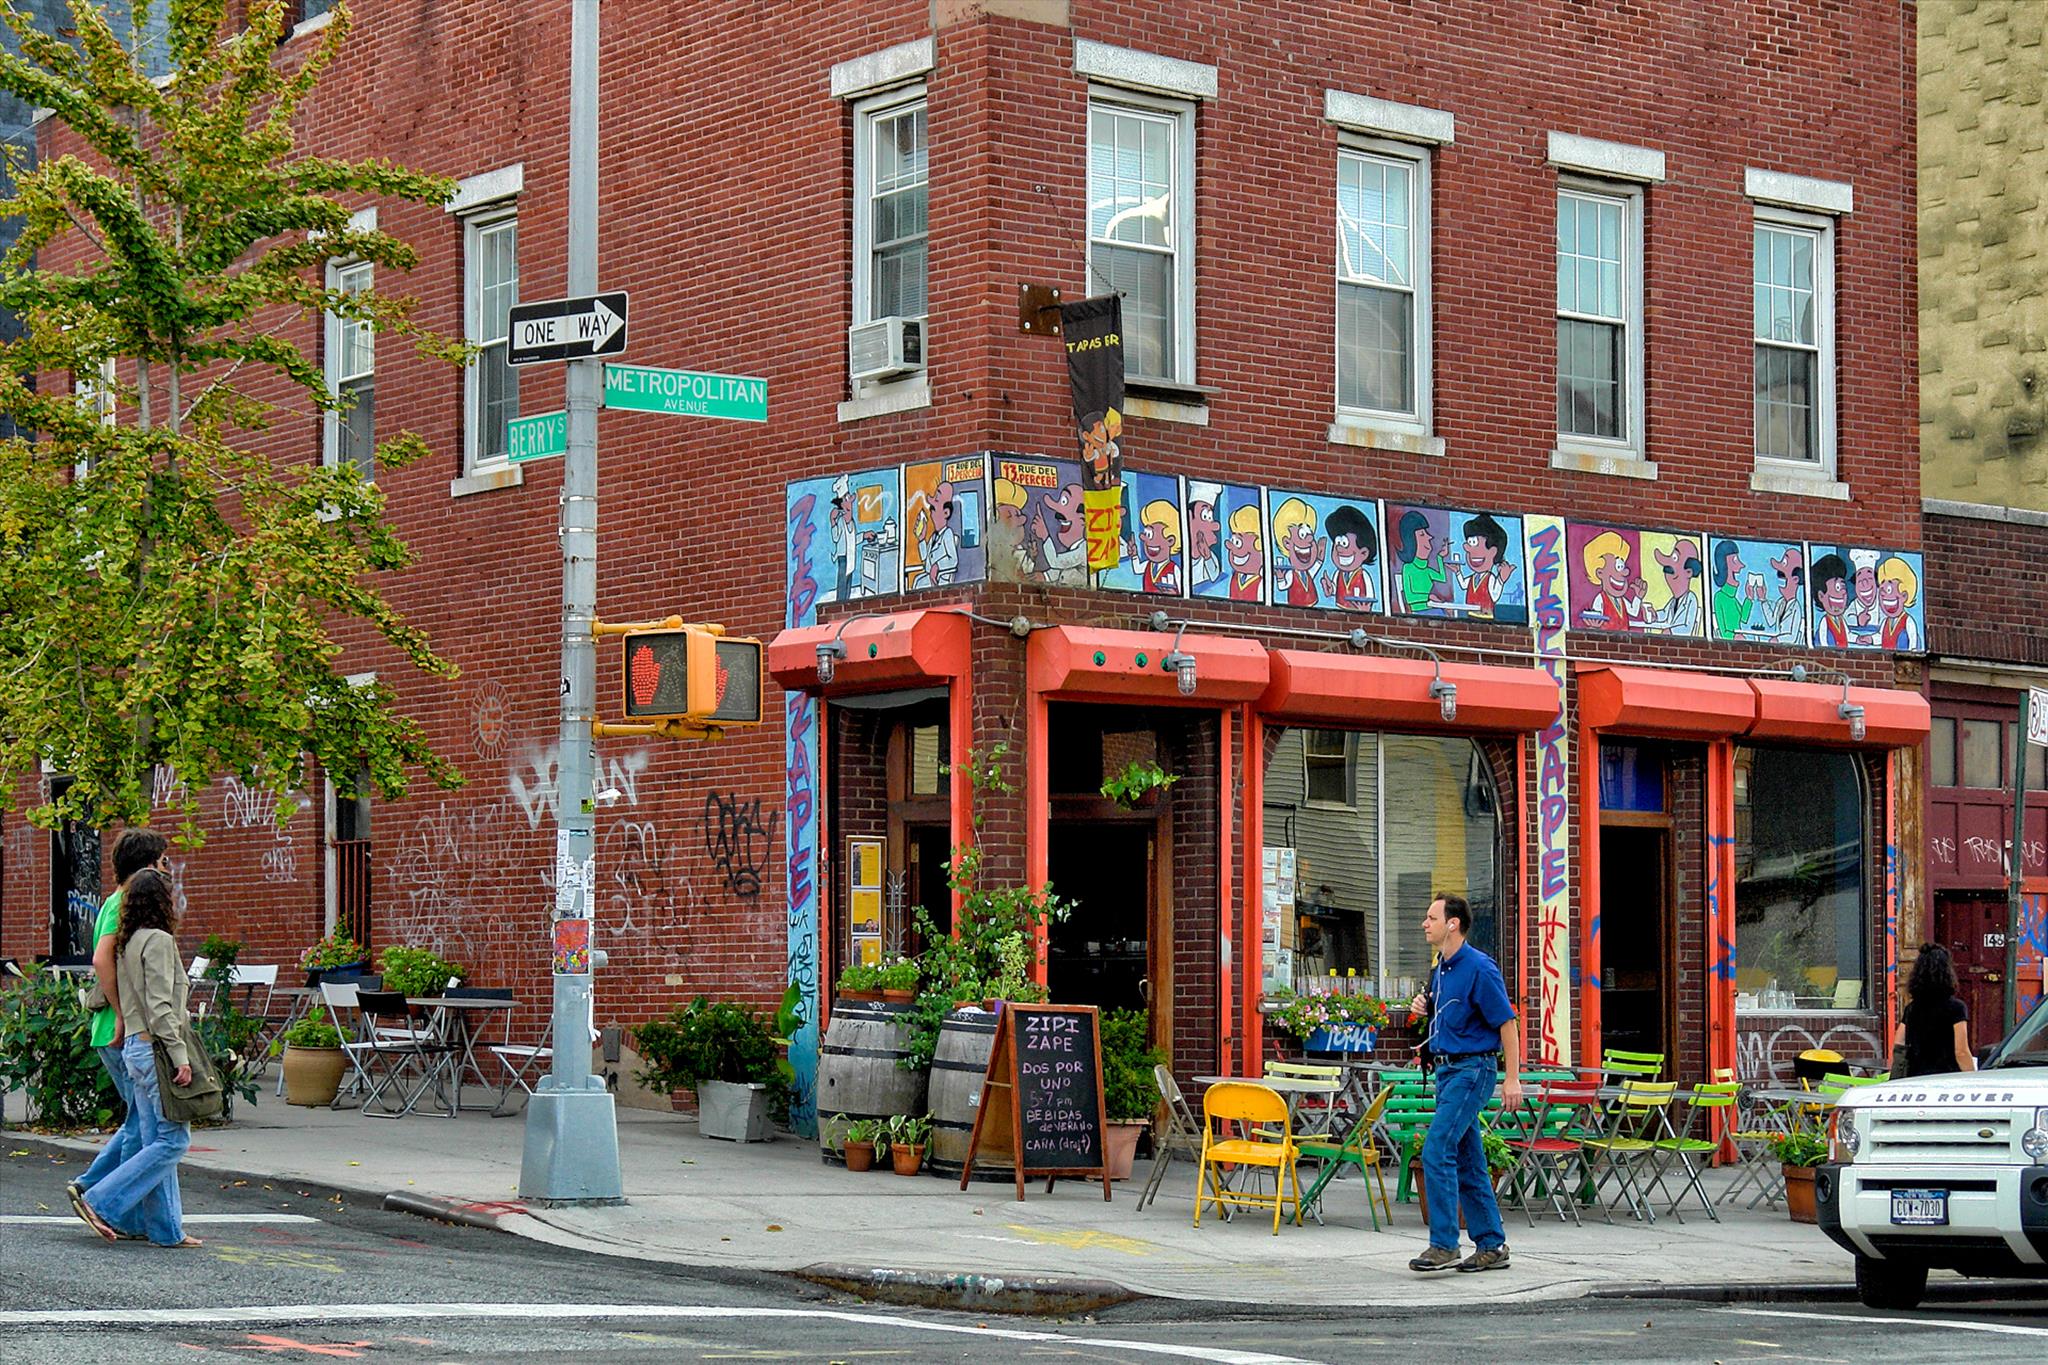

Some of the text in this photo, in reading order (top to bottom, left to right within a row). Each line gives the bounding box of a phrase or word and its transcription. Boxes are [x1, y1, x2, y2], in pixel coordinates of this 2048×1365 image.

[524, 313, 612, 345] ONE WAY
[1066, 337, 1102, 353] TAPAS
[606, 368, 765, 404] METROPOLITAN
[664, 399, 709, 414] AVENUE
[511, 416, 567, 458] BERRY S
[1018, 464, 1036, 474] RUE
[1039, 466, 1056, 476] DEL
[1019, 473, 1056, 487] PERCEBE
[1025, 1016, 1079, 1033] ZIPI
[1027, 1035, 1072, 1052] ZAPE
[1022, 1061, 1084, 1075] DOS POR
[1040, 1077, 1071, 1090] UNO
[1876, 1093, 2014, 1102] LAND ROVER
[1026, 1109, 1082, 1123] BEBIDAS
